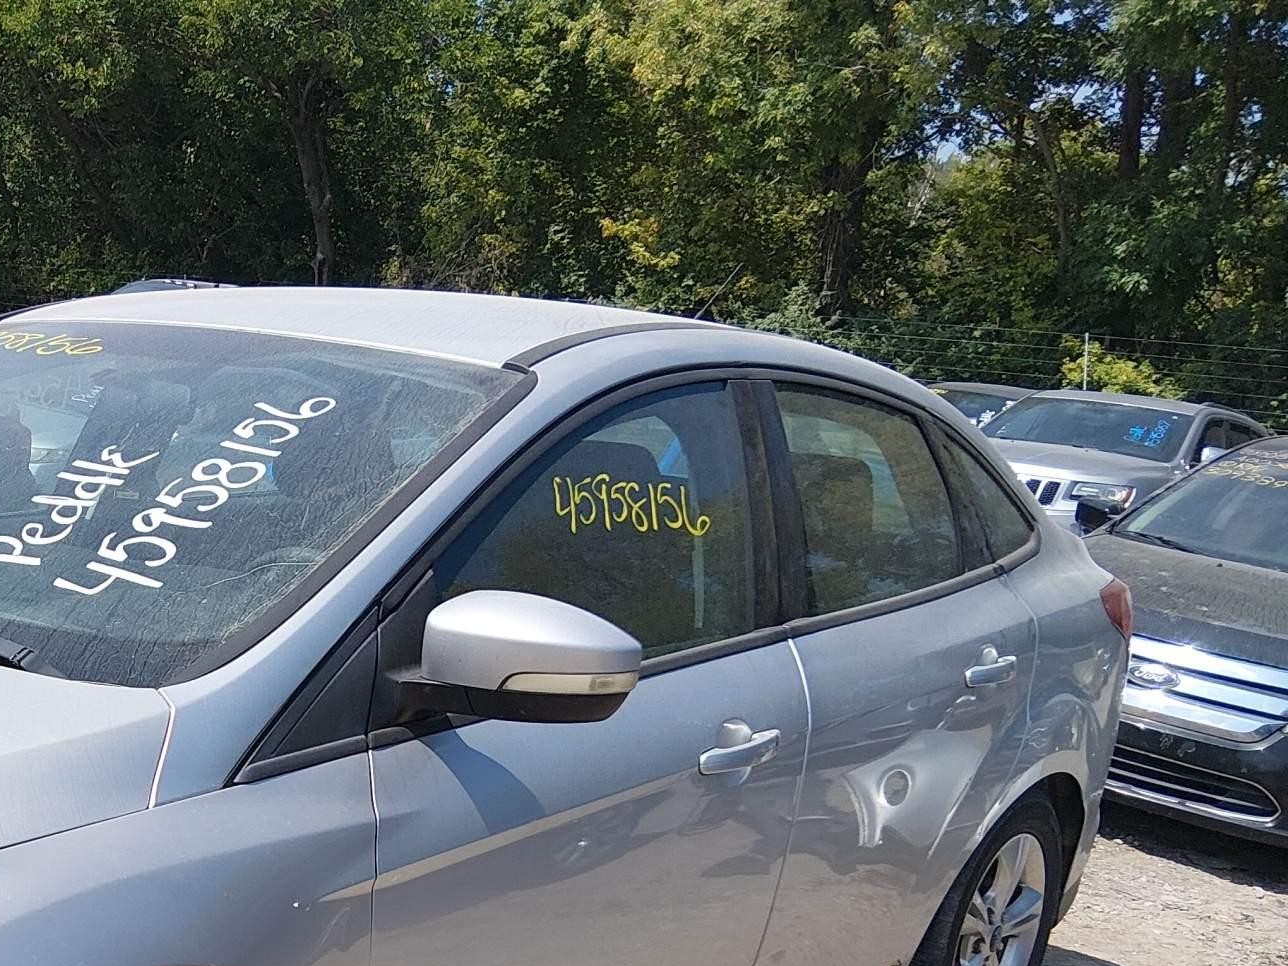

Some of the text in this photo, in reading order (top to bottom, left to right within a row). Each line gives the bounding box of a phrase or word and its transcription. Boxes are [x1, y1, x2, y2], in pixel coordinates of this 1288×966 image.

[53, 396, 337, 595] 45958156
[552, 473, 711, 536] 45958156
[1134, 666, 1169, 682] Ford
